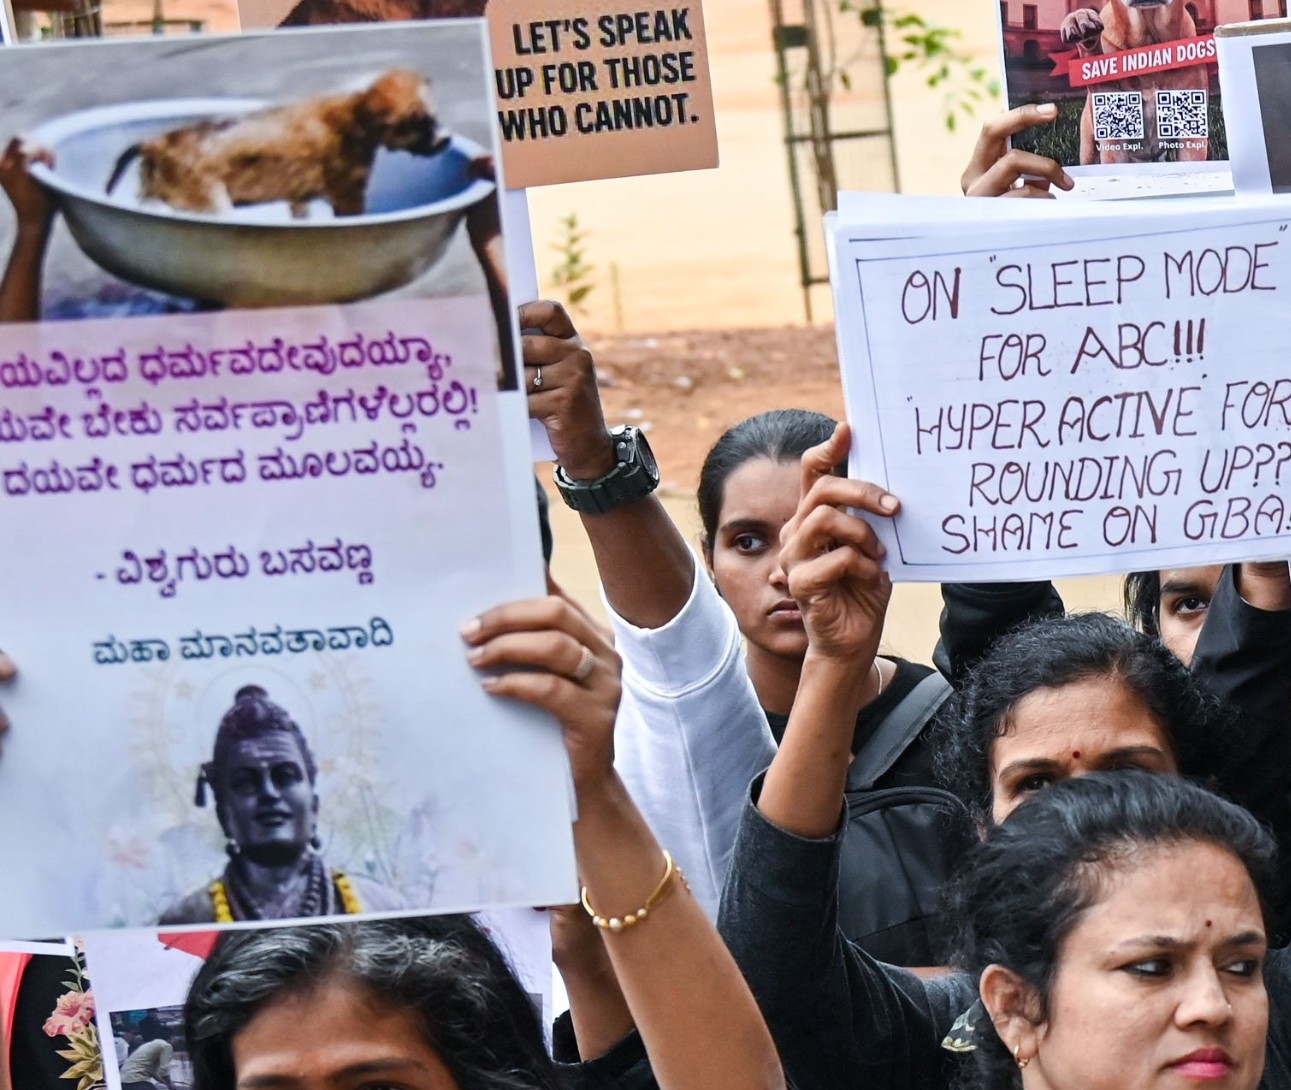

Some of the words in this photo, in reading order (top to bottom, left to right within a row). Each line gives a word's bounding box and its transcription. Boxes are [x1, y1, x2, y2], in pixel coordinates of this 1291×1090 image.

[512, 18, 591, 55] LET'S
[598, 8, 692, 47] SPEAK
[496, 67, 534, 99] UP
[542, 61, 599, 94] FOR
[603, 51, 696, 88] THOSE
[1081, 58, 1118, 81] SAVE
[1122, 47, 1172, 71] INDIAN
[1177, 40, 1215, 61] DOGS
[498, 105, 568, 141] WHO
[575, 93, 699, 134] CANNOT.
[1096, 143, 1120, 151] Video
[1123, 142, 1144, 152] Expl.
[1158, 141, 1183, 150] Photo
[1186, 140, 1207, 151] Expl.
[901, 267, 962, 324] ON
[0, 346, 128, 397] ಯವಿಲ್ಲದ
[979, 333, 1051, 381] FOR
[1071, 318, 1206, 375] ABC!!!
[0, 403, 72, 443] ಯವೇ
[82, 399, 163, 438] ಬೇಕು
[3, 457, 121, 497] ದಯವೇ
[131, 449, 247, 491] ಧರ್ಮದ
[970, 449, 1182, 507] ROUNDING
[941, 509, 1083, 554] SHAME
[1102, 504, 1157, 546] ON
[117, 545, 250, 598] ವಿಶ್ವಗುರು
[260, 537, 375, 584] ಬಸವಣ್ಣ
[93, 633, 170, 665] ಮಹಾ
[180, 616, 395, 661] ಮಾನವತಾವಾದಿ
